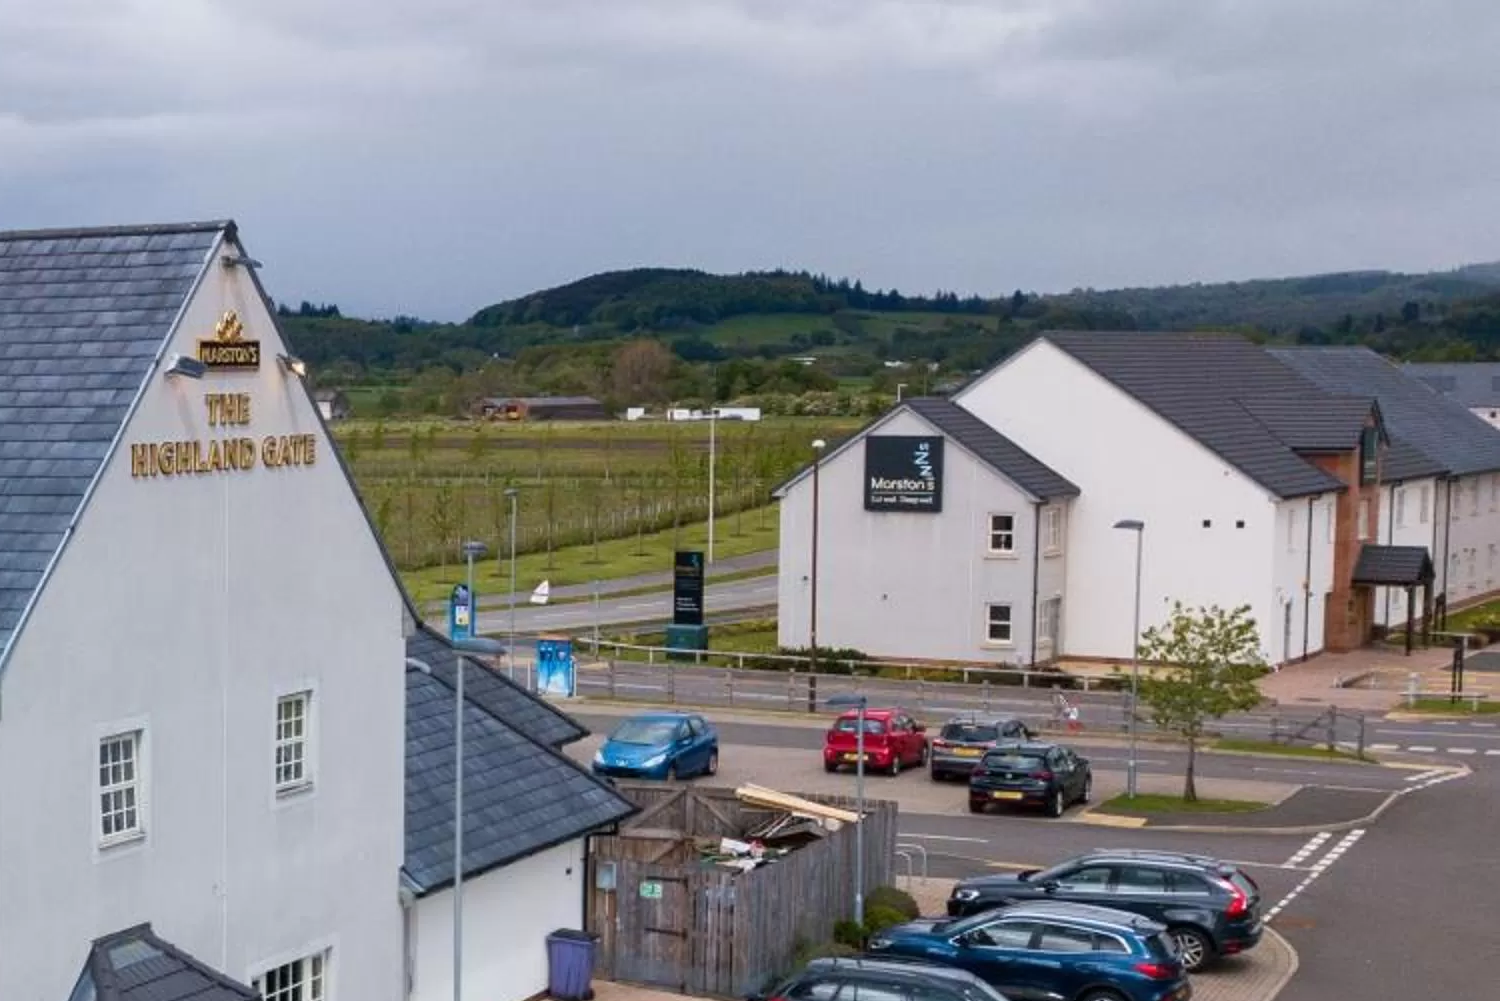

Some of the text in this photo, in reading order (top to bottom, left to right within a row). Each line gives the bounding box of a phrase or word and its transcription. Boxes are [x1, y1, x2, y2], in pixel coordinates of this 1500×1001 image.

[204, 393, 252, 426] THE
[131, 434, 316, 477] HIGHLAND GATE
